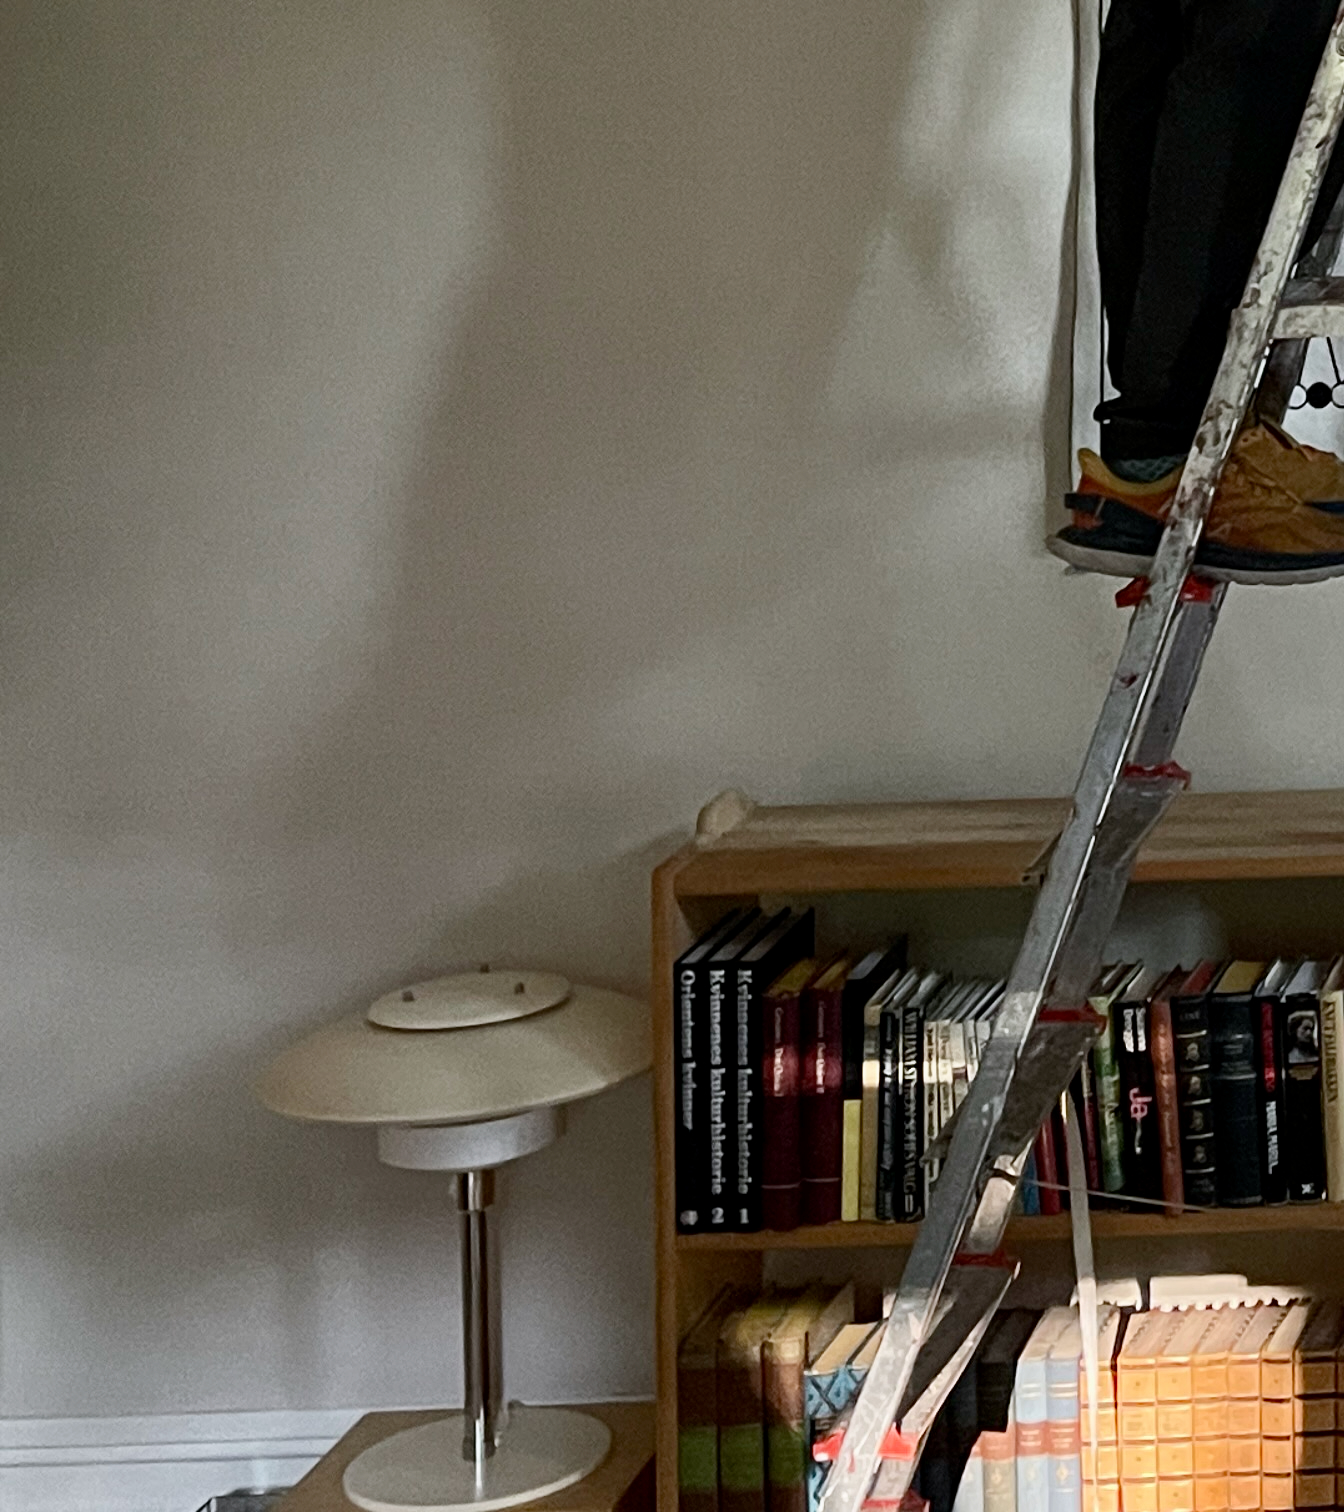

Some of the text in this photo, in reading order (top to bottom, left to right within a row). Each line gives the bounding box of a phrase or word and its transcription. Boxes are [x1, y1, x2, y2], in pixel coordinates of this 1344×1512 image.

[679, 969, 697, 1131] Orientens kvinner
[709, 969, 727, 1225] Kvinnenes kulturhistorie 2
[737, 969, 753, 1225] Kvinnenes kulturhistorie 1
